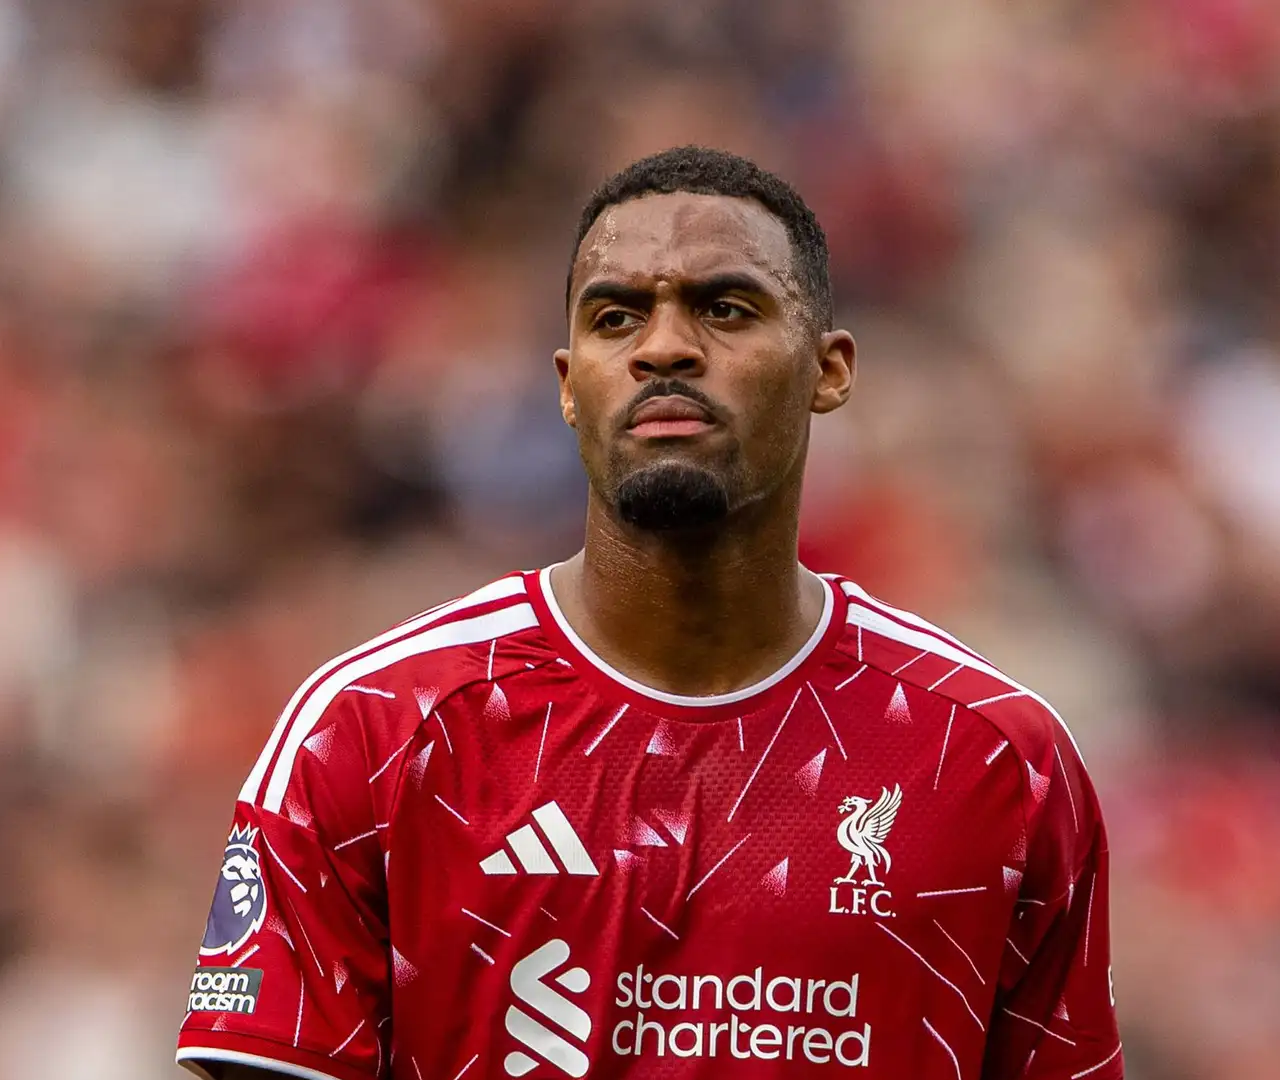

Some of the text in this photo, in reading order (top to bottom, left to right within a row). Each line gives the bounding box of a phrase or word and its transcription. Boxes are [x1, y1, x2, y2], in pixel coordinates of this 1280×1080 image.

[828, 887, 897, 918] L.F.C.
[190, 972, 249, 993] room
[615, 963, 859, 1017] standard
[612, 1011, 872, 1067] chartered
